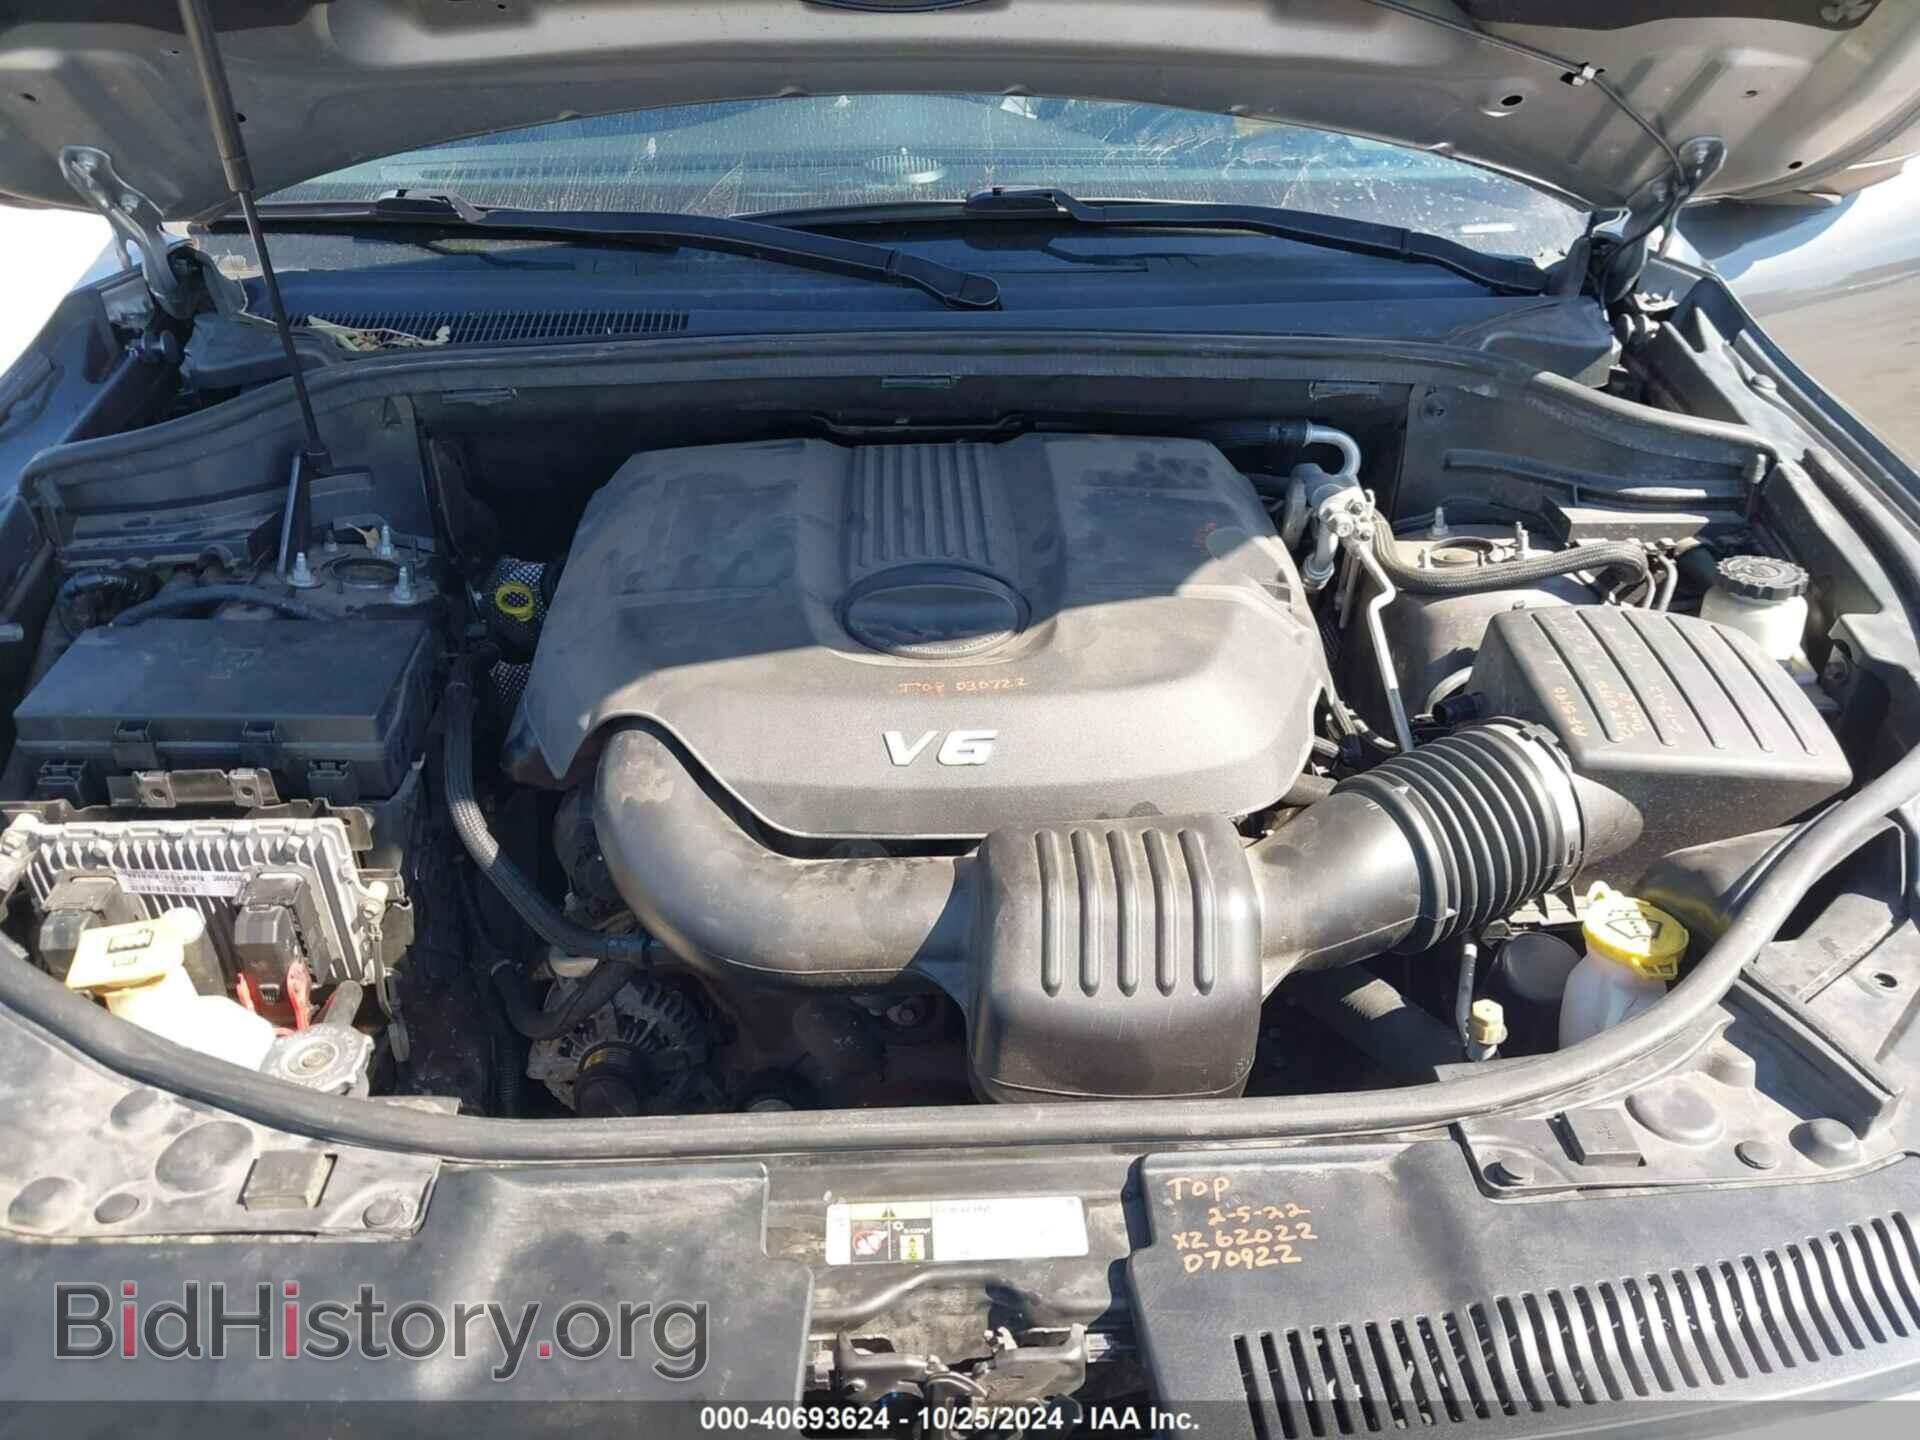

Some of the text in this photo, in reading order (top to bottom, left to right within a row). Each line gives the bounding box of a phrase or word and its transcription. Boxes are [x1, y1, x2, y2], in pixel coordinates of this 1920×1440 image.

[882, 729, 999, 767] V6
[1166, 1176, 1231, 1202] TOP
[1207, 1202, 1312, 1226] 2-5-22
[1182, 1244, 1303, 1273] 070922
